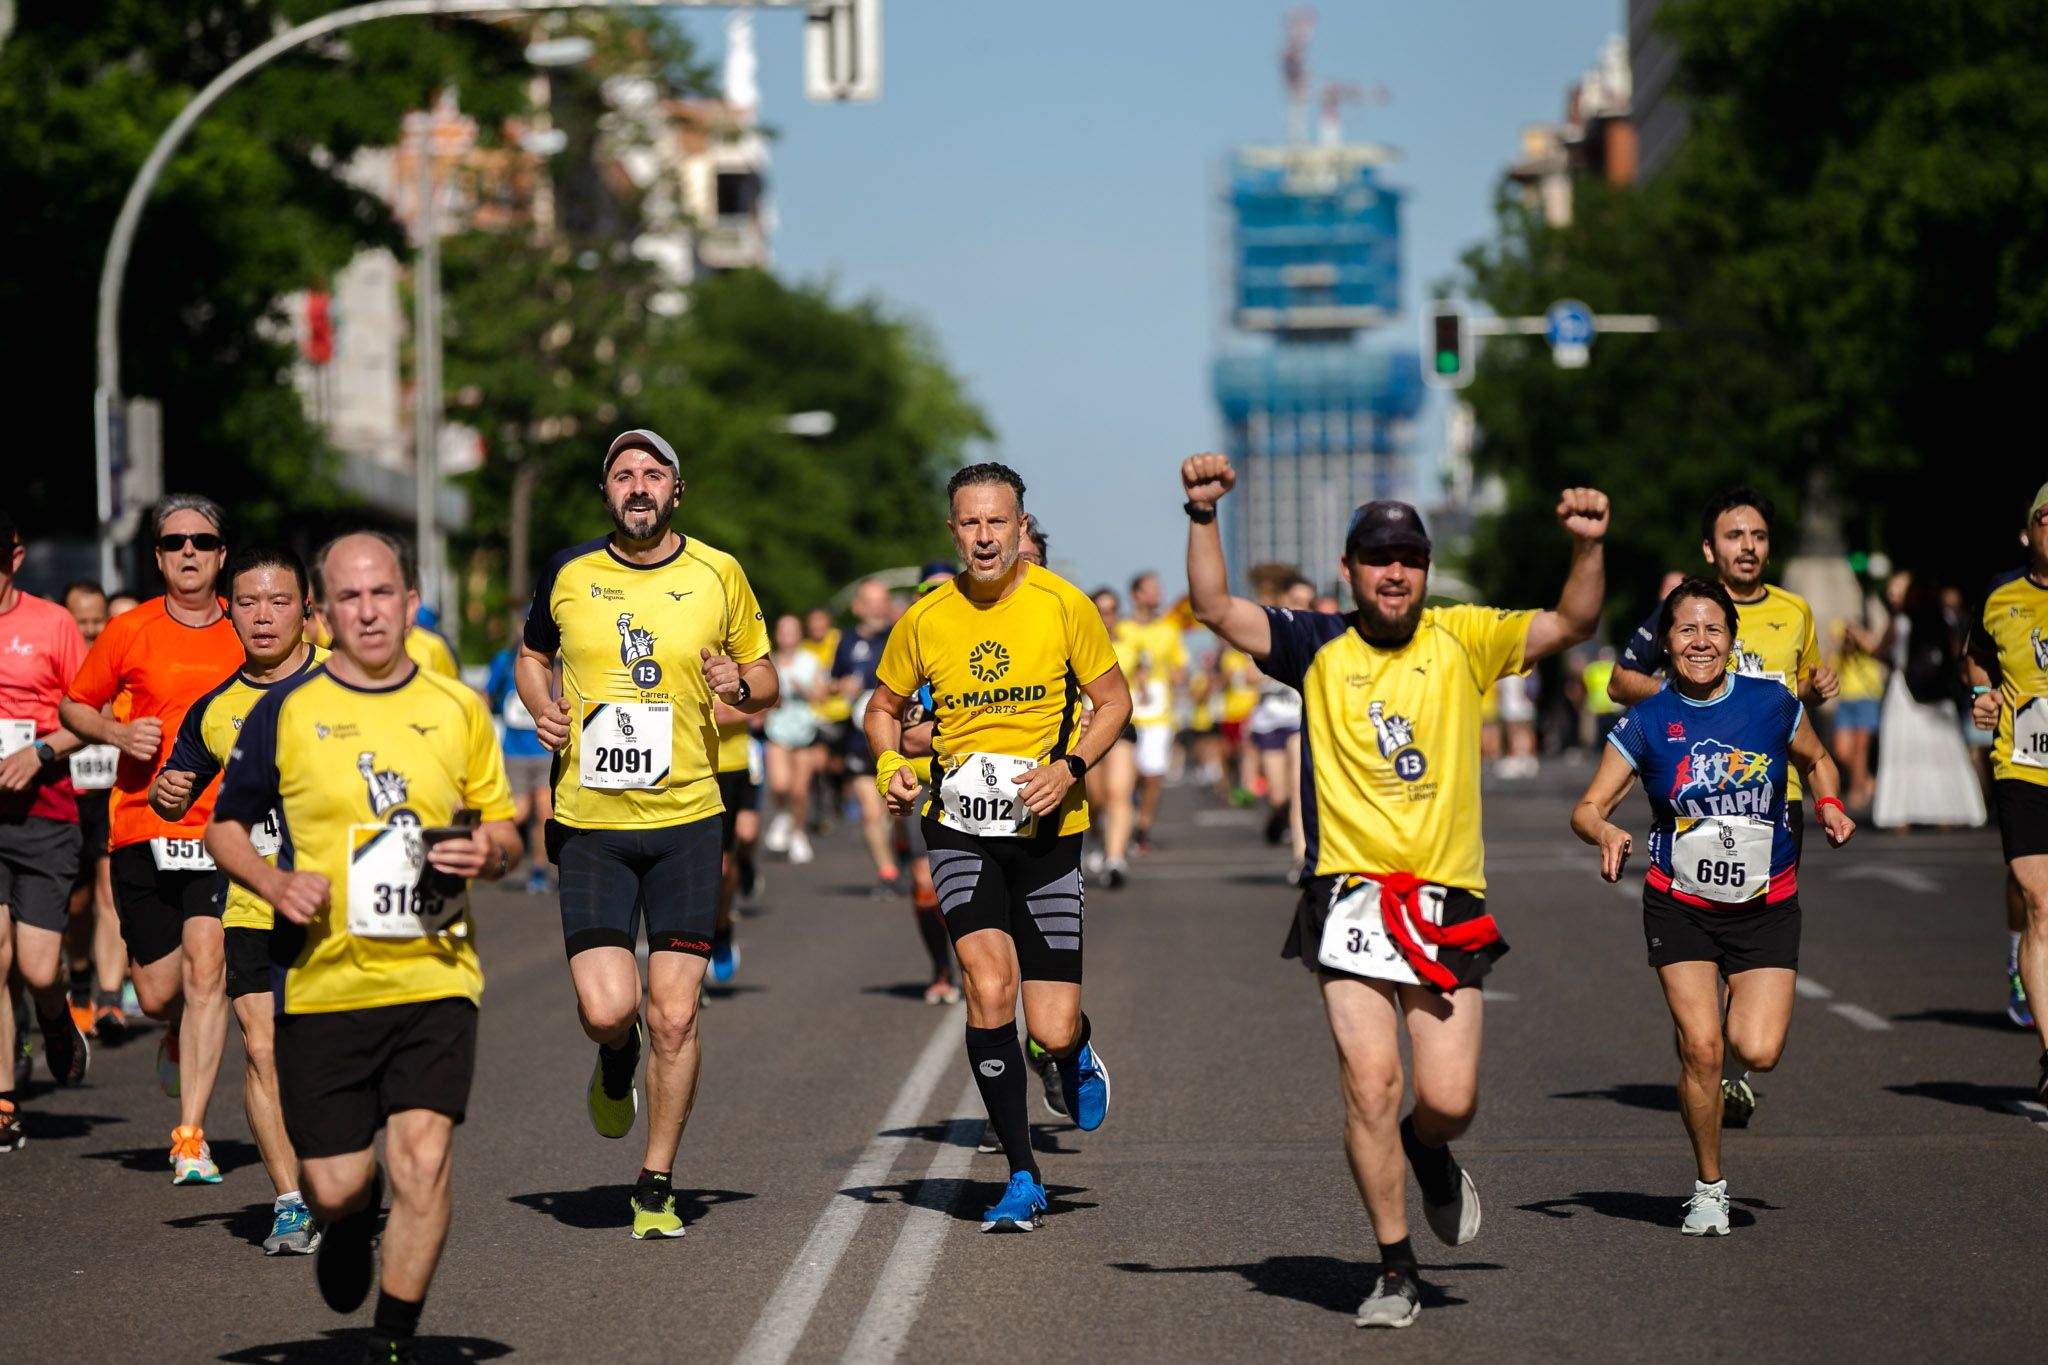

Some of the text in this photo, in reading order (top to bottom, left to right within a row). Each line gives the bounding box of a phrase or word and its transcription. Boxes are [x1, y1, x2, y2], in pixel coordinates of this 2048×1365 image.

[638, 666, 656, 682] 13
[640, 690, 669, 699] Carrera
[595, 746, 652, 773] 2091
[1398, 755, 1422, 775] 13
[959, 795, 1014, 821] 3012
[1704, 782, 1772, 817] TAPIA
[1696, 858, 1746, 888] 695
